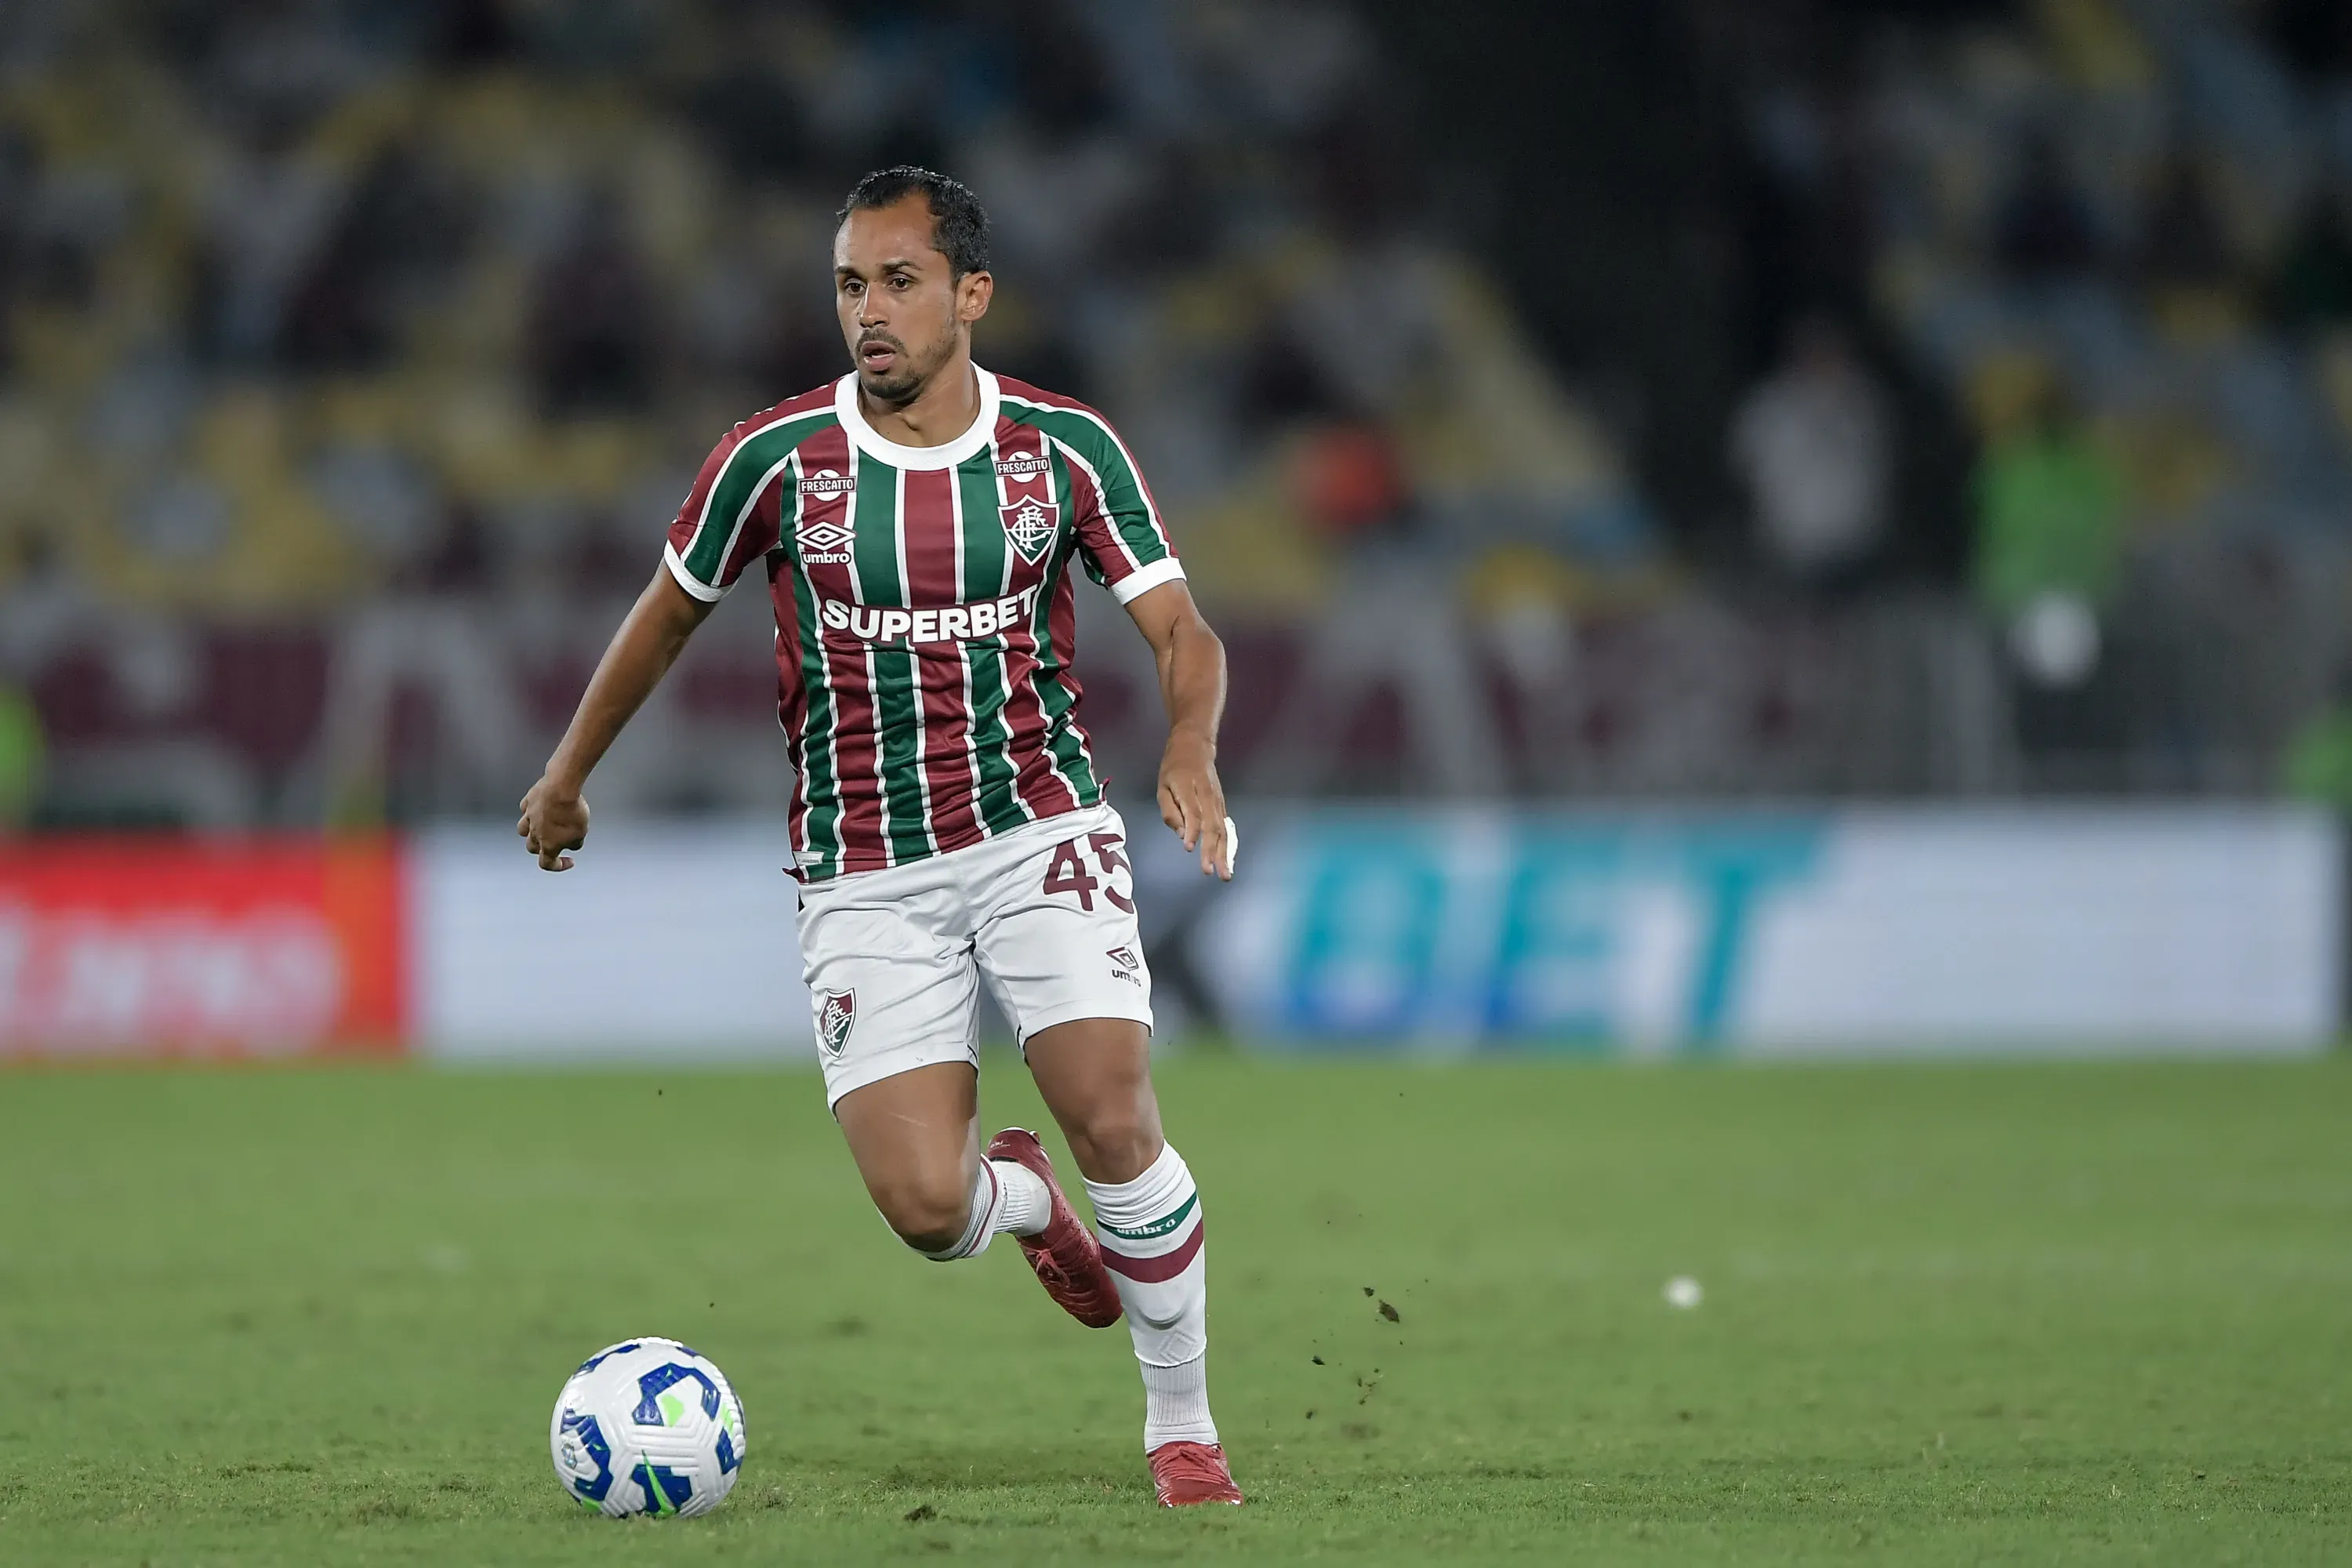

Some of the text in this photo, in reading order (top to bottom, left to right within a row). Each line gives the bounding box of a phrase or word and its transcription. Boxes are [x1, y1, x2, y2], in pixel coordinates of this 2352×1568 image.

[996, 459, 1048, 474] FRESCATTO
[800, 478, 854, 492] FRESCATTO
[802, 551, 851, 564] umbro
[822, 583, 1038, 643] SUPERBET
[1043, 833, 1134, 914] 45
[1116, 1218, 1176, 1236] umbro
